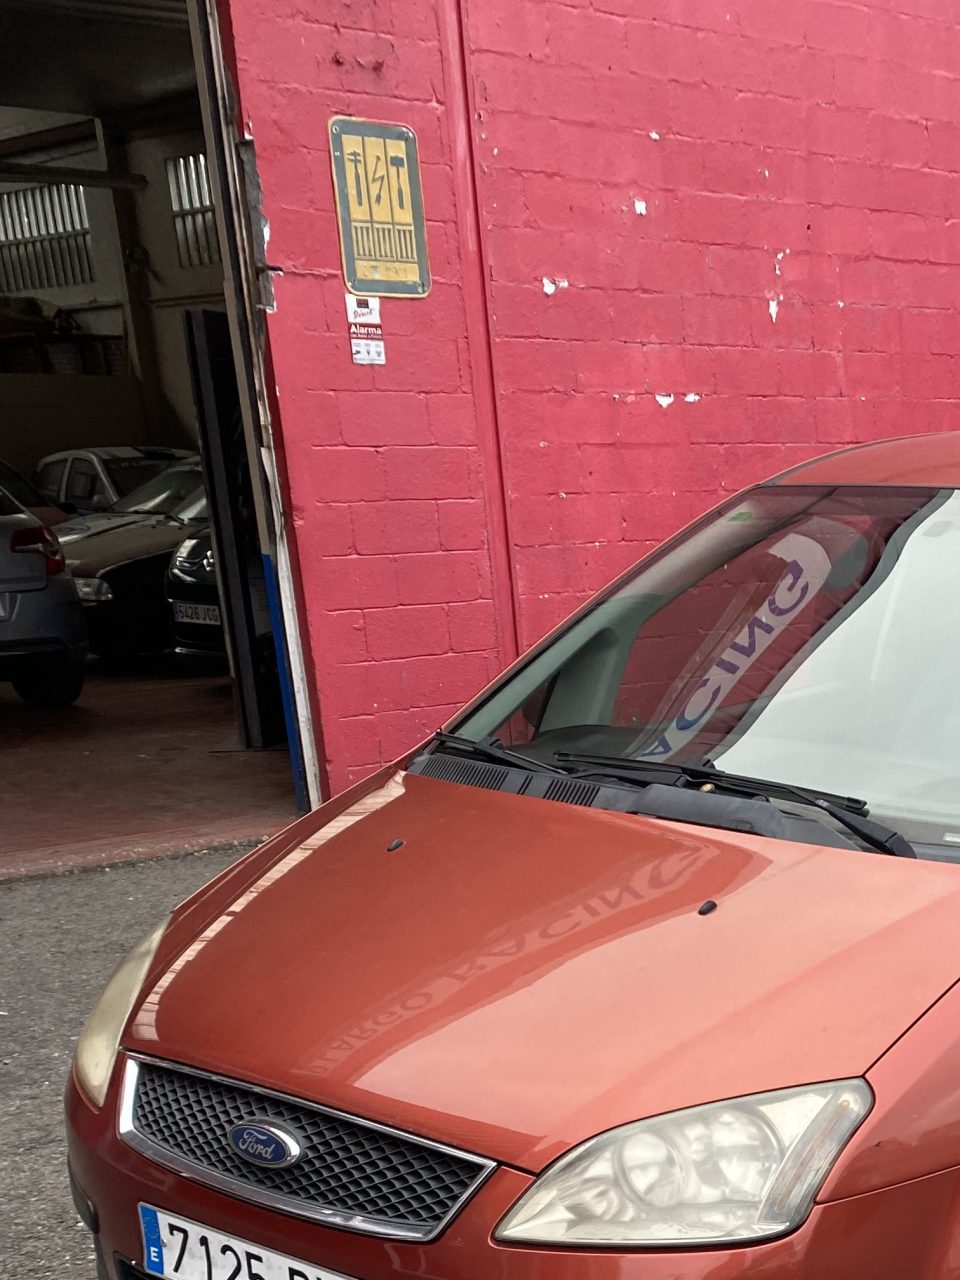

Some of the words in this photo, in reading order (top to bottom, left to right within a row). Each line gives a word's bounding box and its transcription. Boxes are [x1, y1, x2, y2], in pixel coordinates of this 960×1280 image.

[350, 323, 382, 335] Alarma
[239, 1129, 276, 1159] Ford
[150, 1246, 159, 1262] E
